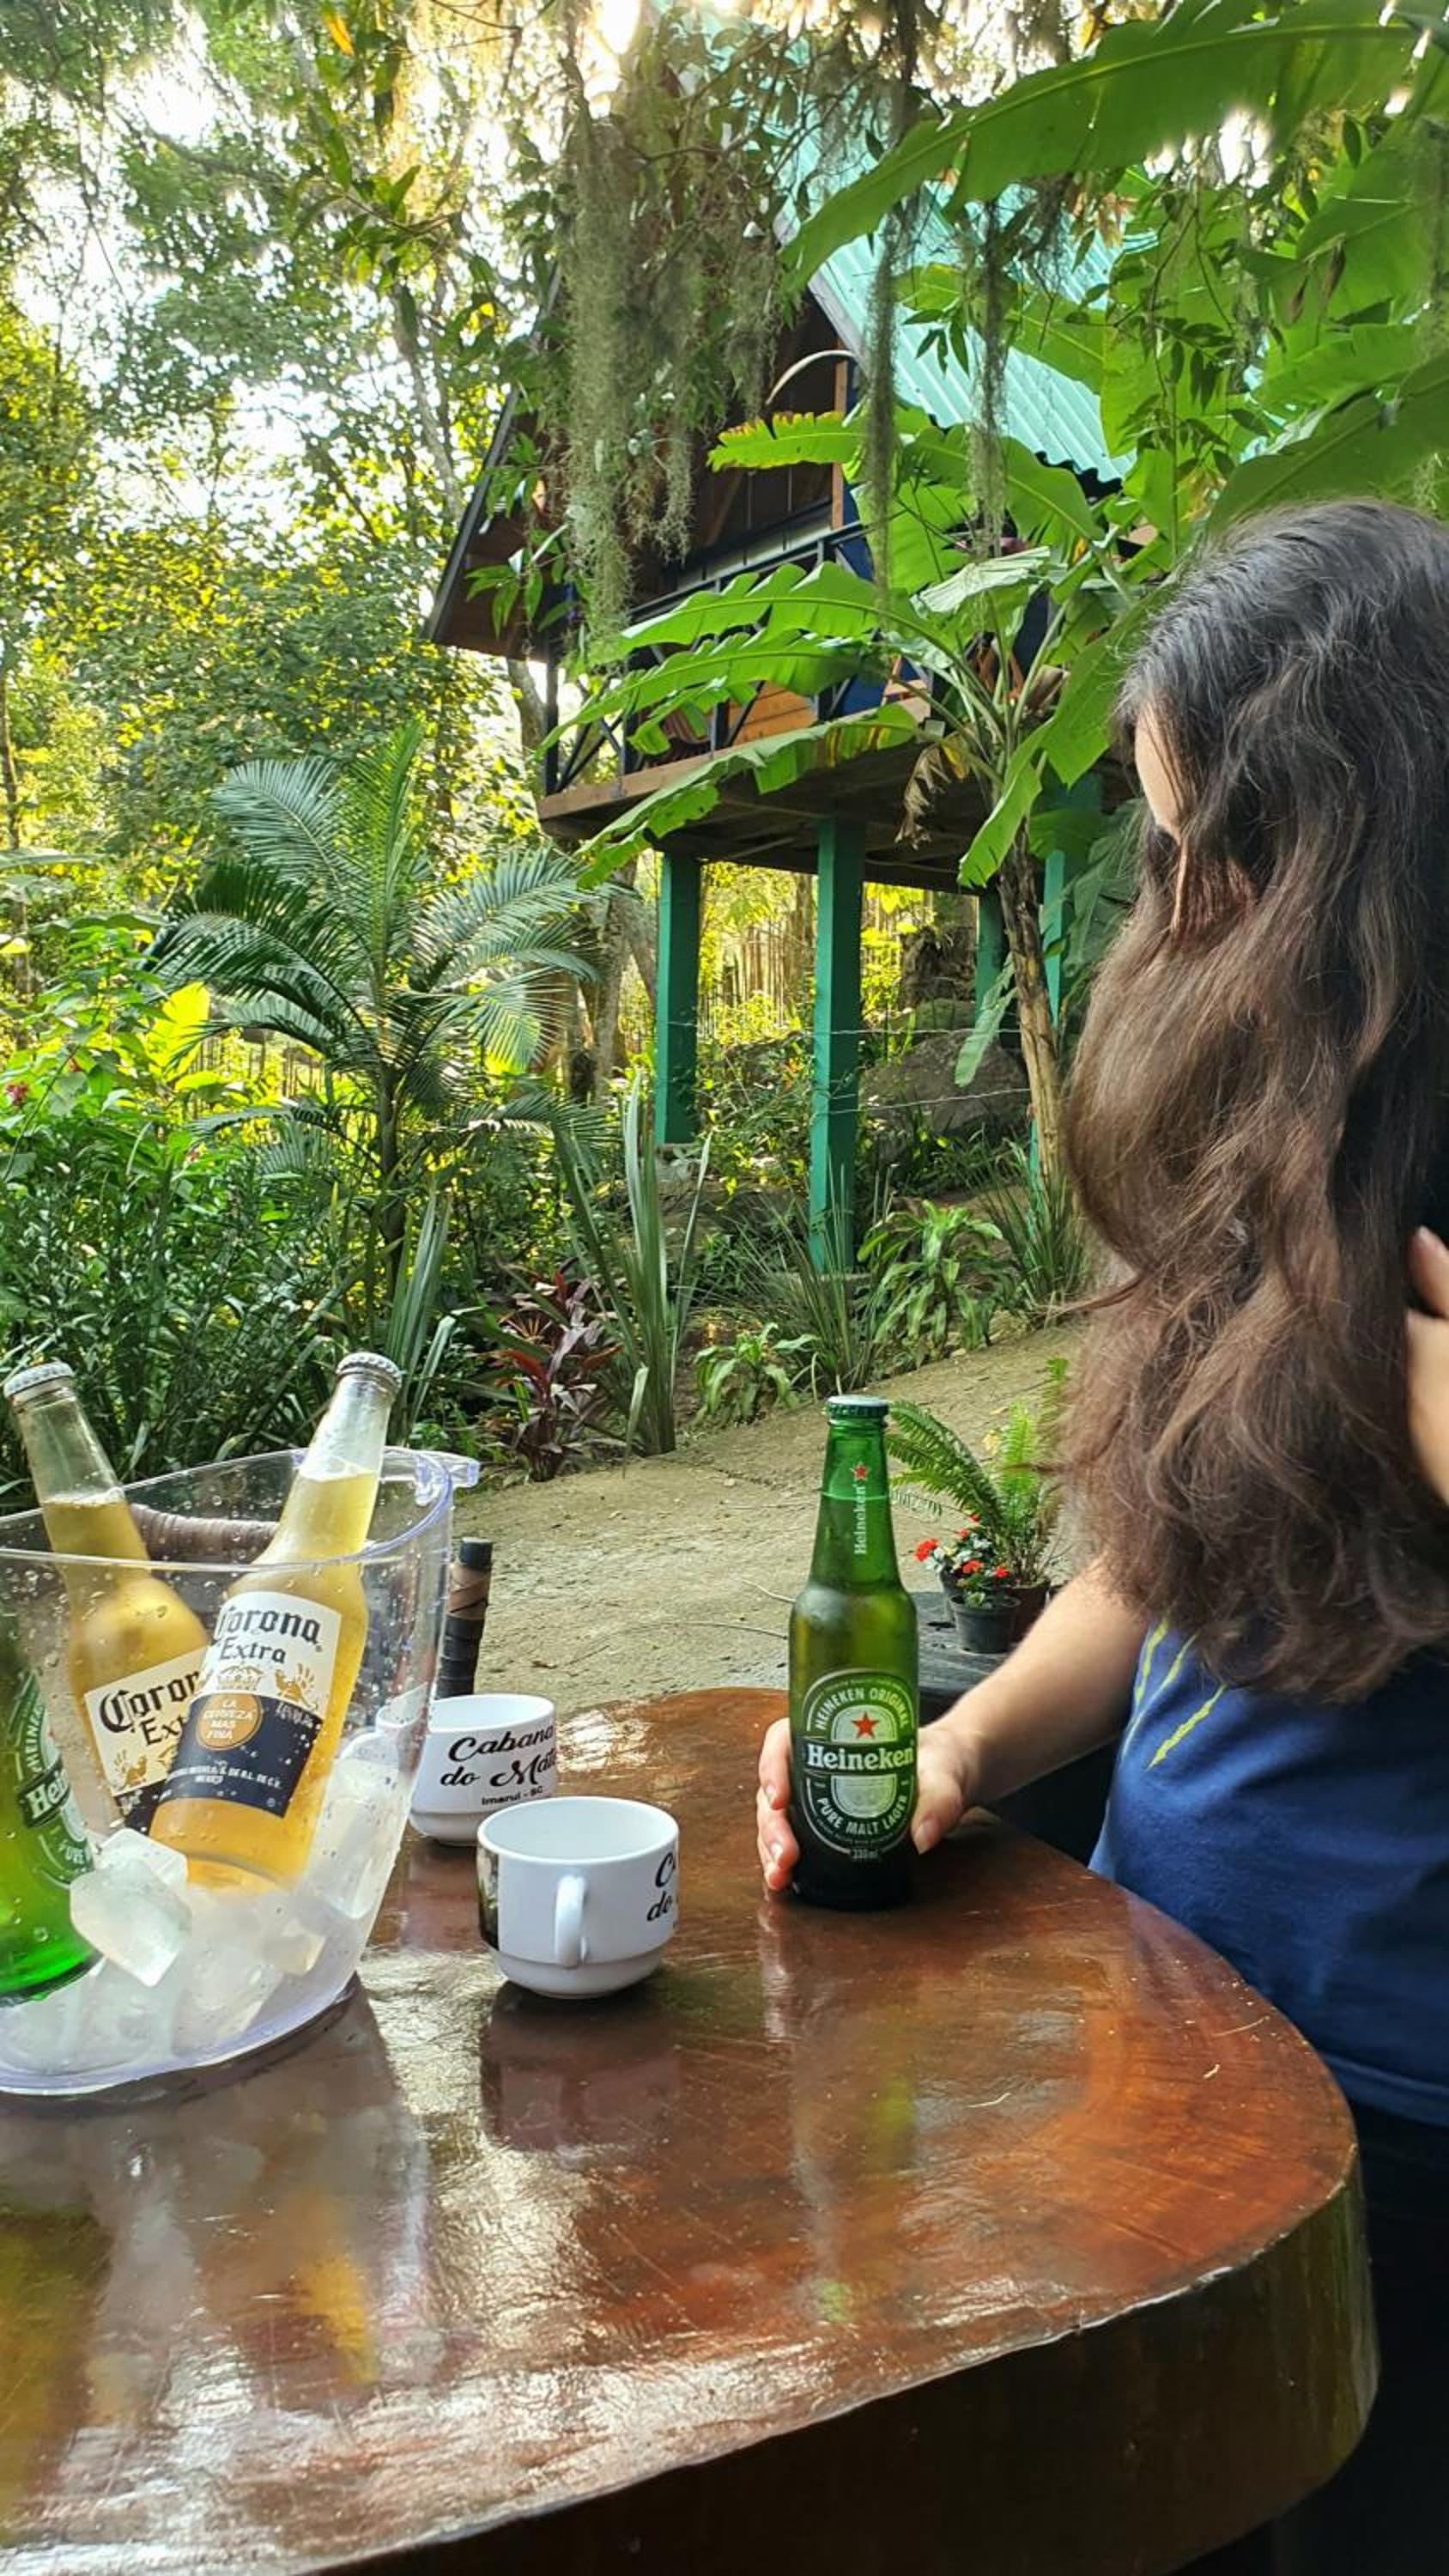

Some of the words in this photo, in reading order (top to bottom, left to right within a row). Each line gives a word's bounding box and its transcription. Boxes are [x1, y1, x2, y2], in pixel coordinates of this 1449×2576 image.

[220, 1637, 286, 1664] Extra
[815, 1688, 865, 1730] HEINEKEN
[870, 1687, 910, 1729] ORIGINAL
[447, 1725, 554, 1762] Cabana
[808, 1742, 913, 1771] Heineken
[440, 1766, 481, 1787] do
[489, 1748, 556, 1787] Mat
[816, 1797, 844, 1829] PURE
[845, 1820, 879, 1835] MALT
[881, 1795, 907, 1830] LAGER
[655, 1851, 676, 1887] C
